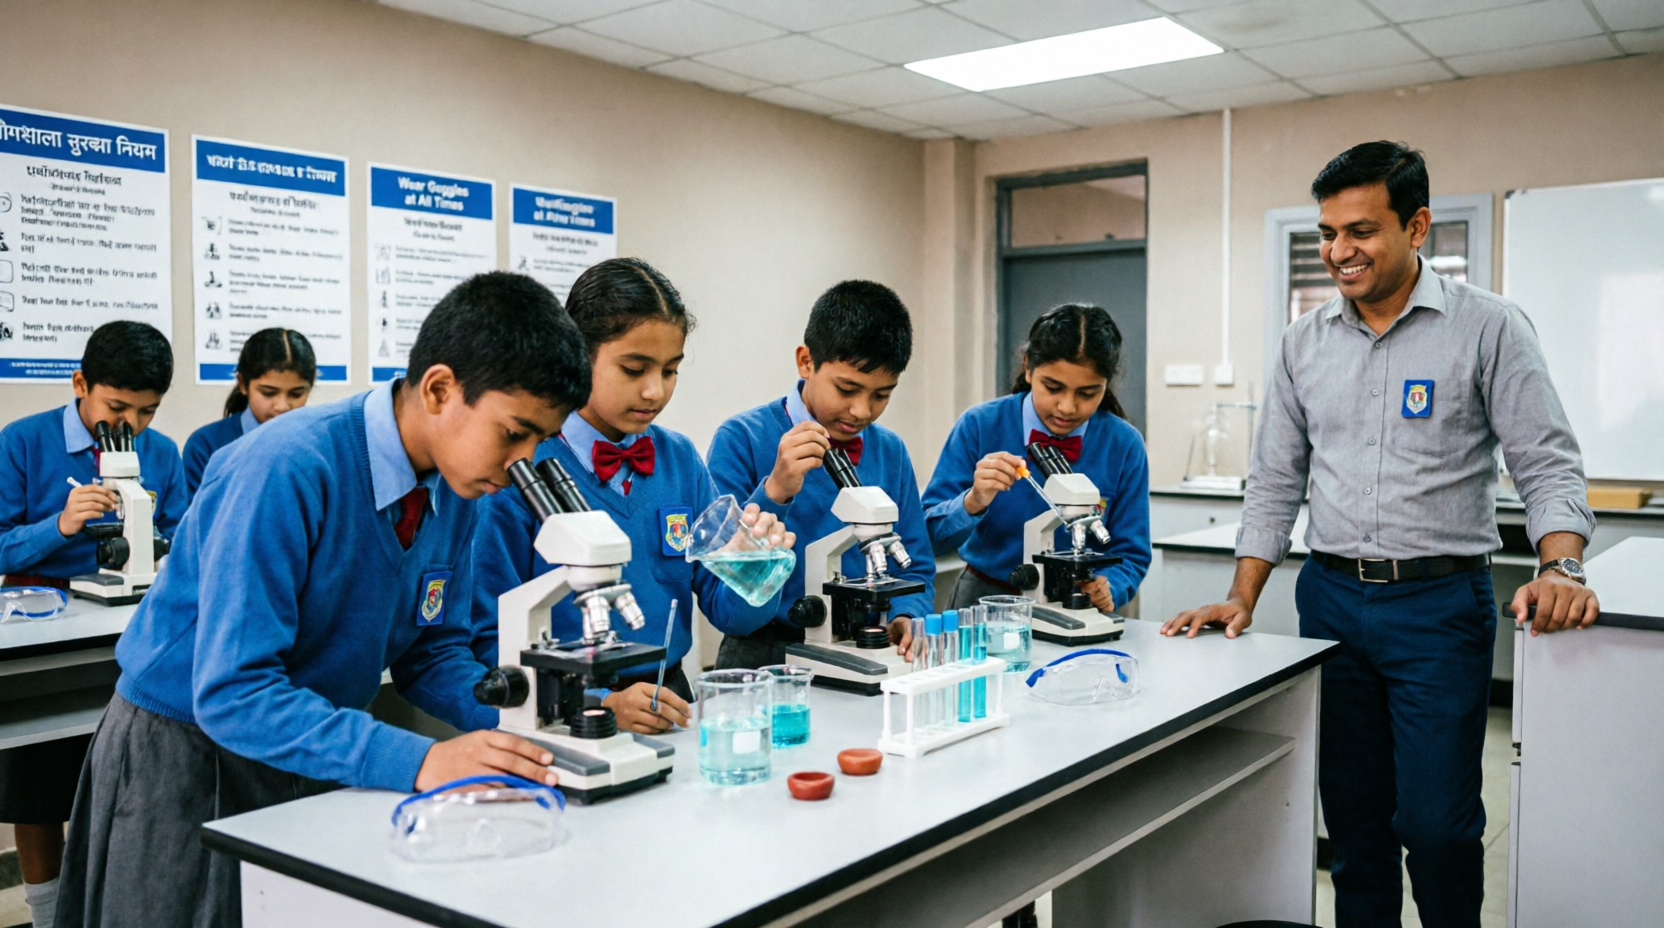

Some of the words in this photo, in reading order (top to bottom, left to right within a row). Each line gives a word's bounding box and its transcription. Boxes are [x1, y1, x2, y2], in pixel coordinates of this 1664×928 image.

[116, 135, 157, 160] नियम
[397, 176, 426, 192] Wear
[404, 193, 417, 206] at
[418, 194, 432, 208] All
